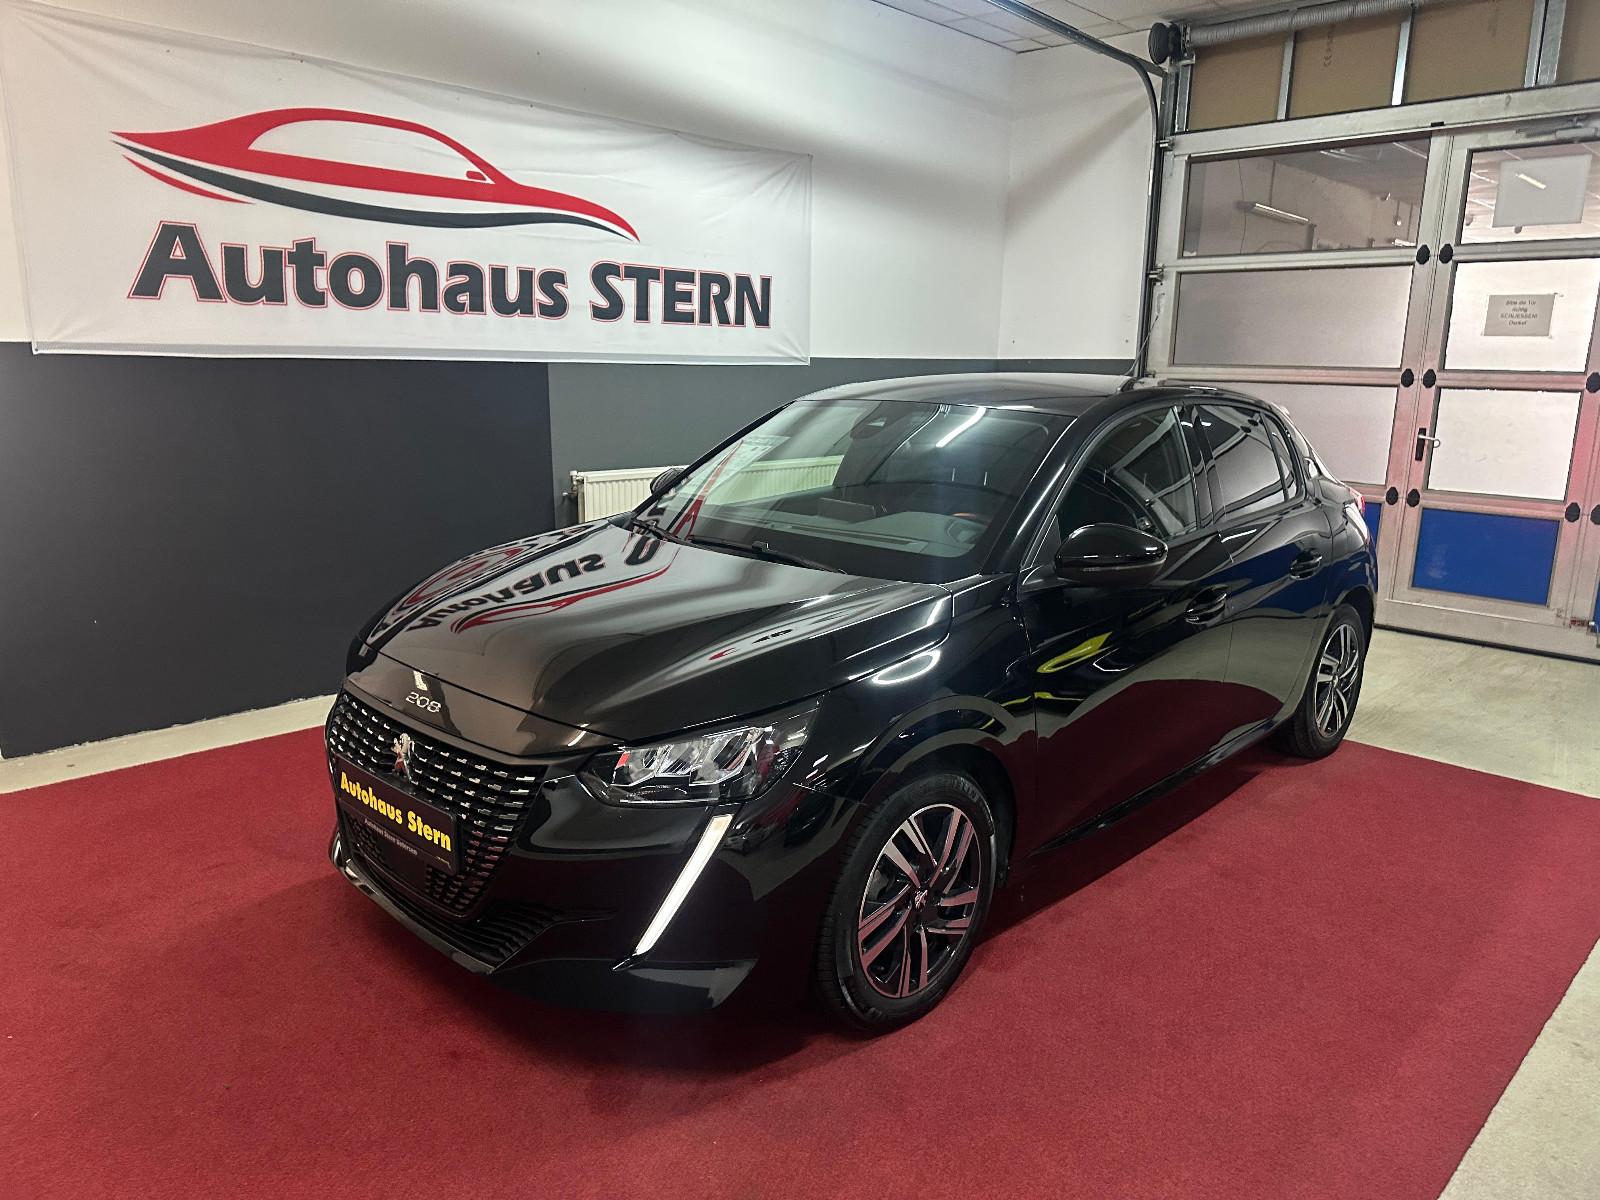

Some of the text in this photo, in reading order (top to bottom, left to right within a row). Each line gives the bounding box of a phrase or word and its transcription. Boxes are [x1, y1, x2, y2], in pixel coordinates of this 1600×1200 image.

[127, 220, 773, 328] Autohaus STERN
[405, 691, 442, 713] 208
[340, 771, 403, 825] Autohaus
[407, 810, 452, 852] Stern
